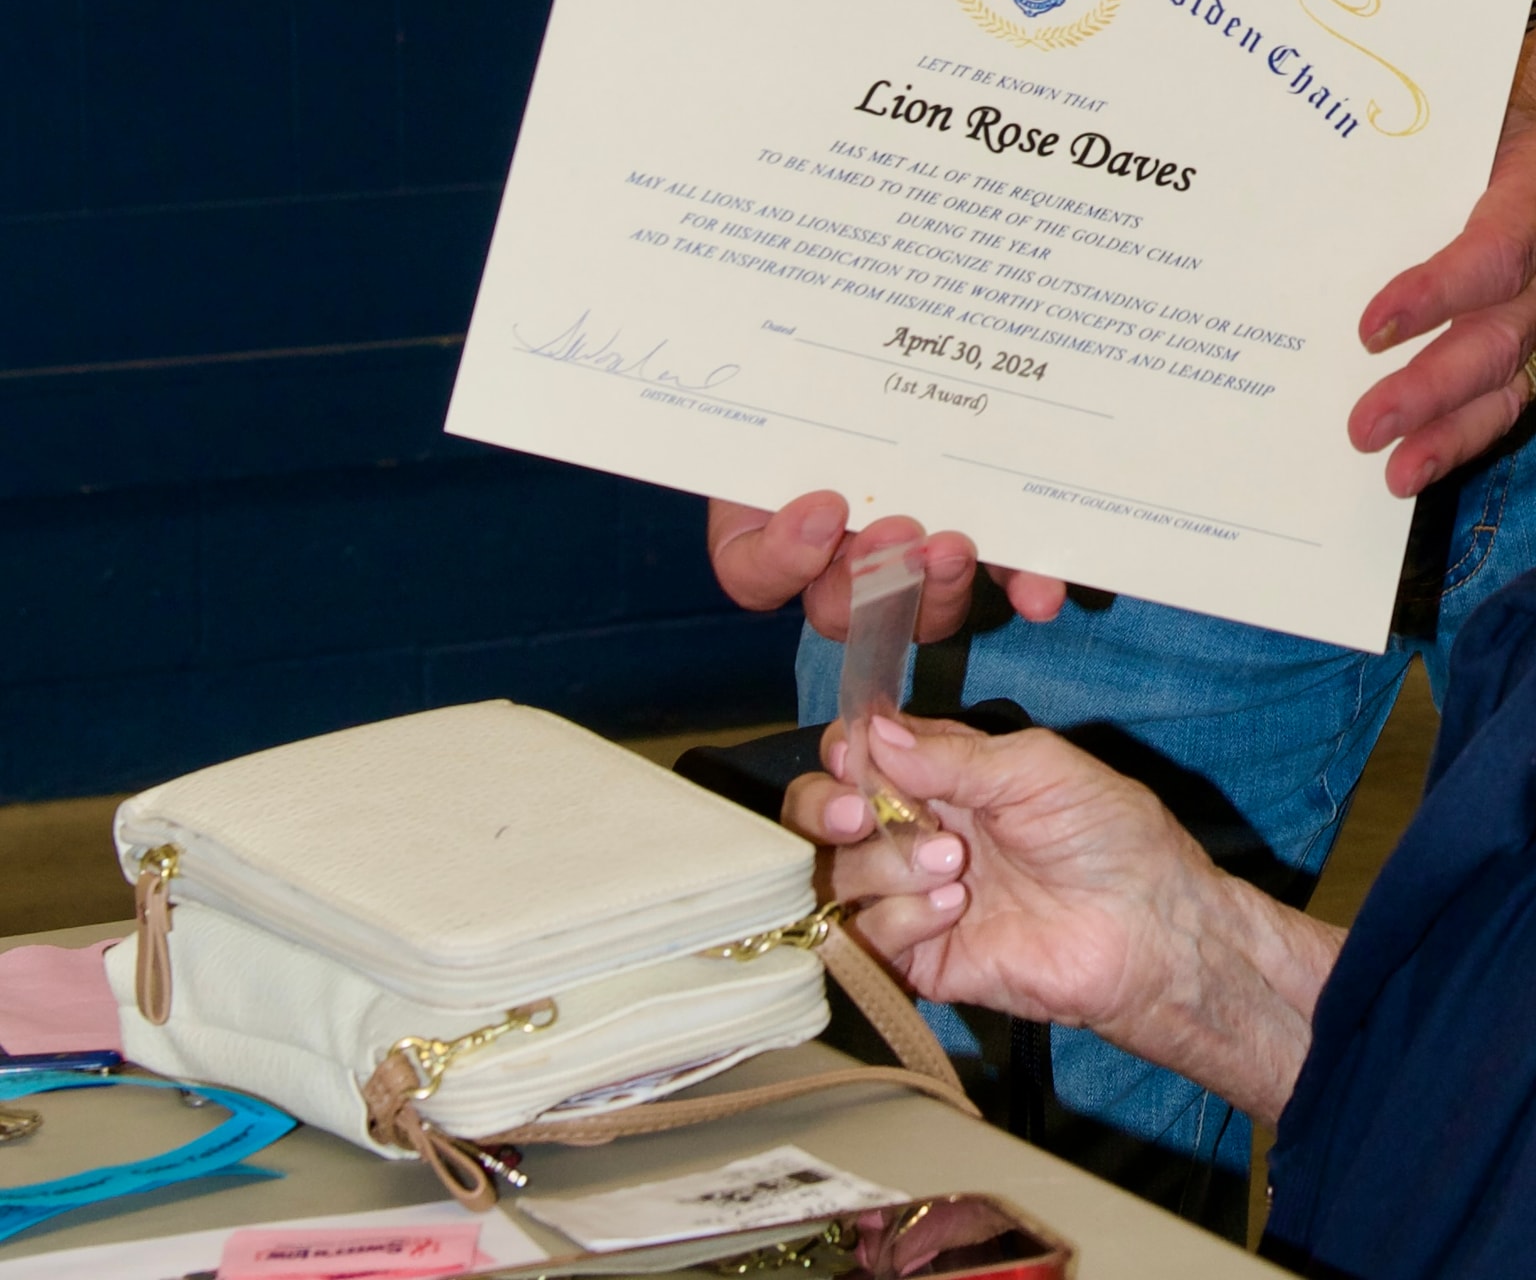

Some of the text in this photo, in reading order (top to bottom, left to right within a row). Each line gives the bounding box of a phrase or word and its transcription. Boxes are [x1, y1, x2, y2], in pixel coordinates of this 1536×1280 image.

[917, 56, 1108, 112] LET IT BE KNOWN THAT
[1266, 44, 1360, 139] Chain
[854, 79, 1197, 192] Lion Rose Daves
[758, 149, 1202, 270] TO BE NAMED TO THE ORDER OF THE GOLDEN CHAIN
[829, 141, 1143, 228] HAS MET ALL OF THE REQUIREMENTS
[626, 171, 1306, 351] MAY ALL LIONS AND LIONESSES RECOGNIZE THIS OUTSTANDING LION OR LIONESS
[897, 212, 1051, 260] DURING THE YEAR
[630, 229, 1275, 397] AND TAKE INSPIRATION FROM HIS/HER ACCOMPLISHMENTS AND LEADERSHIP
[680, 213, 1240, 362] FOR HIS/HER DEDICATION TO THE WORTHY CONCEPTS OF LIONISM
[882, 325, 1049, 383] April 30, 2024
[883, 371, 989, 417] (1st Award)
[640, 389, 767, 426] DISTRICT GOVERNOR
[1022, 482, 1241, 541] DISTRICT GOLDEN CHAIN CHAIRMAN
